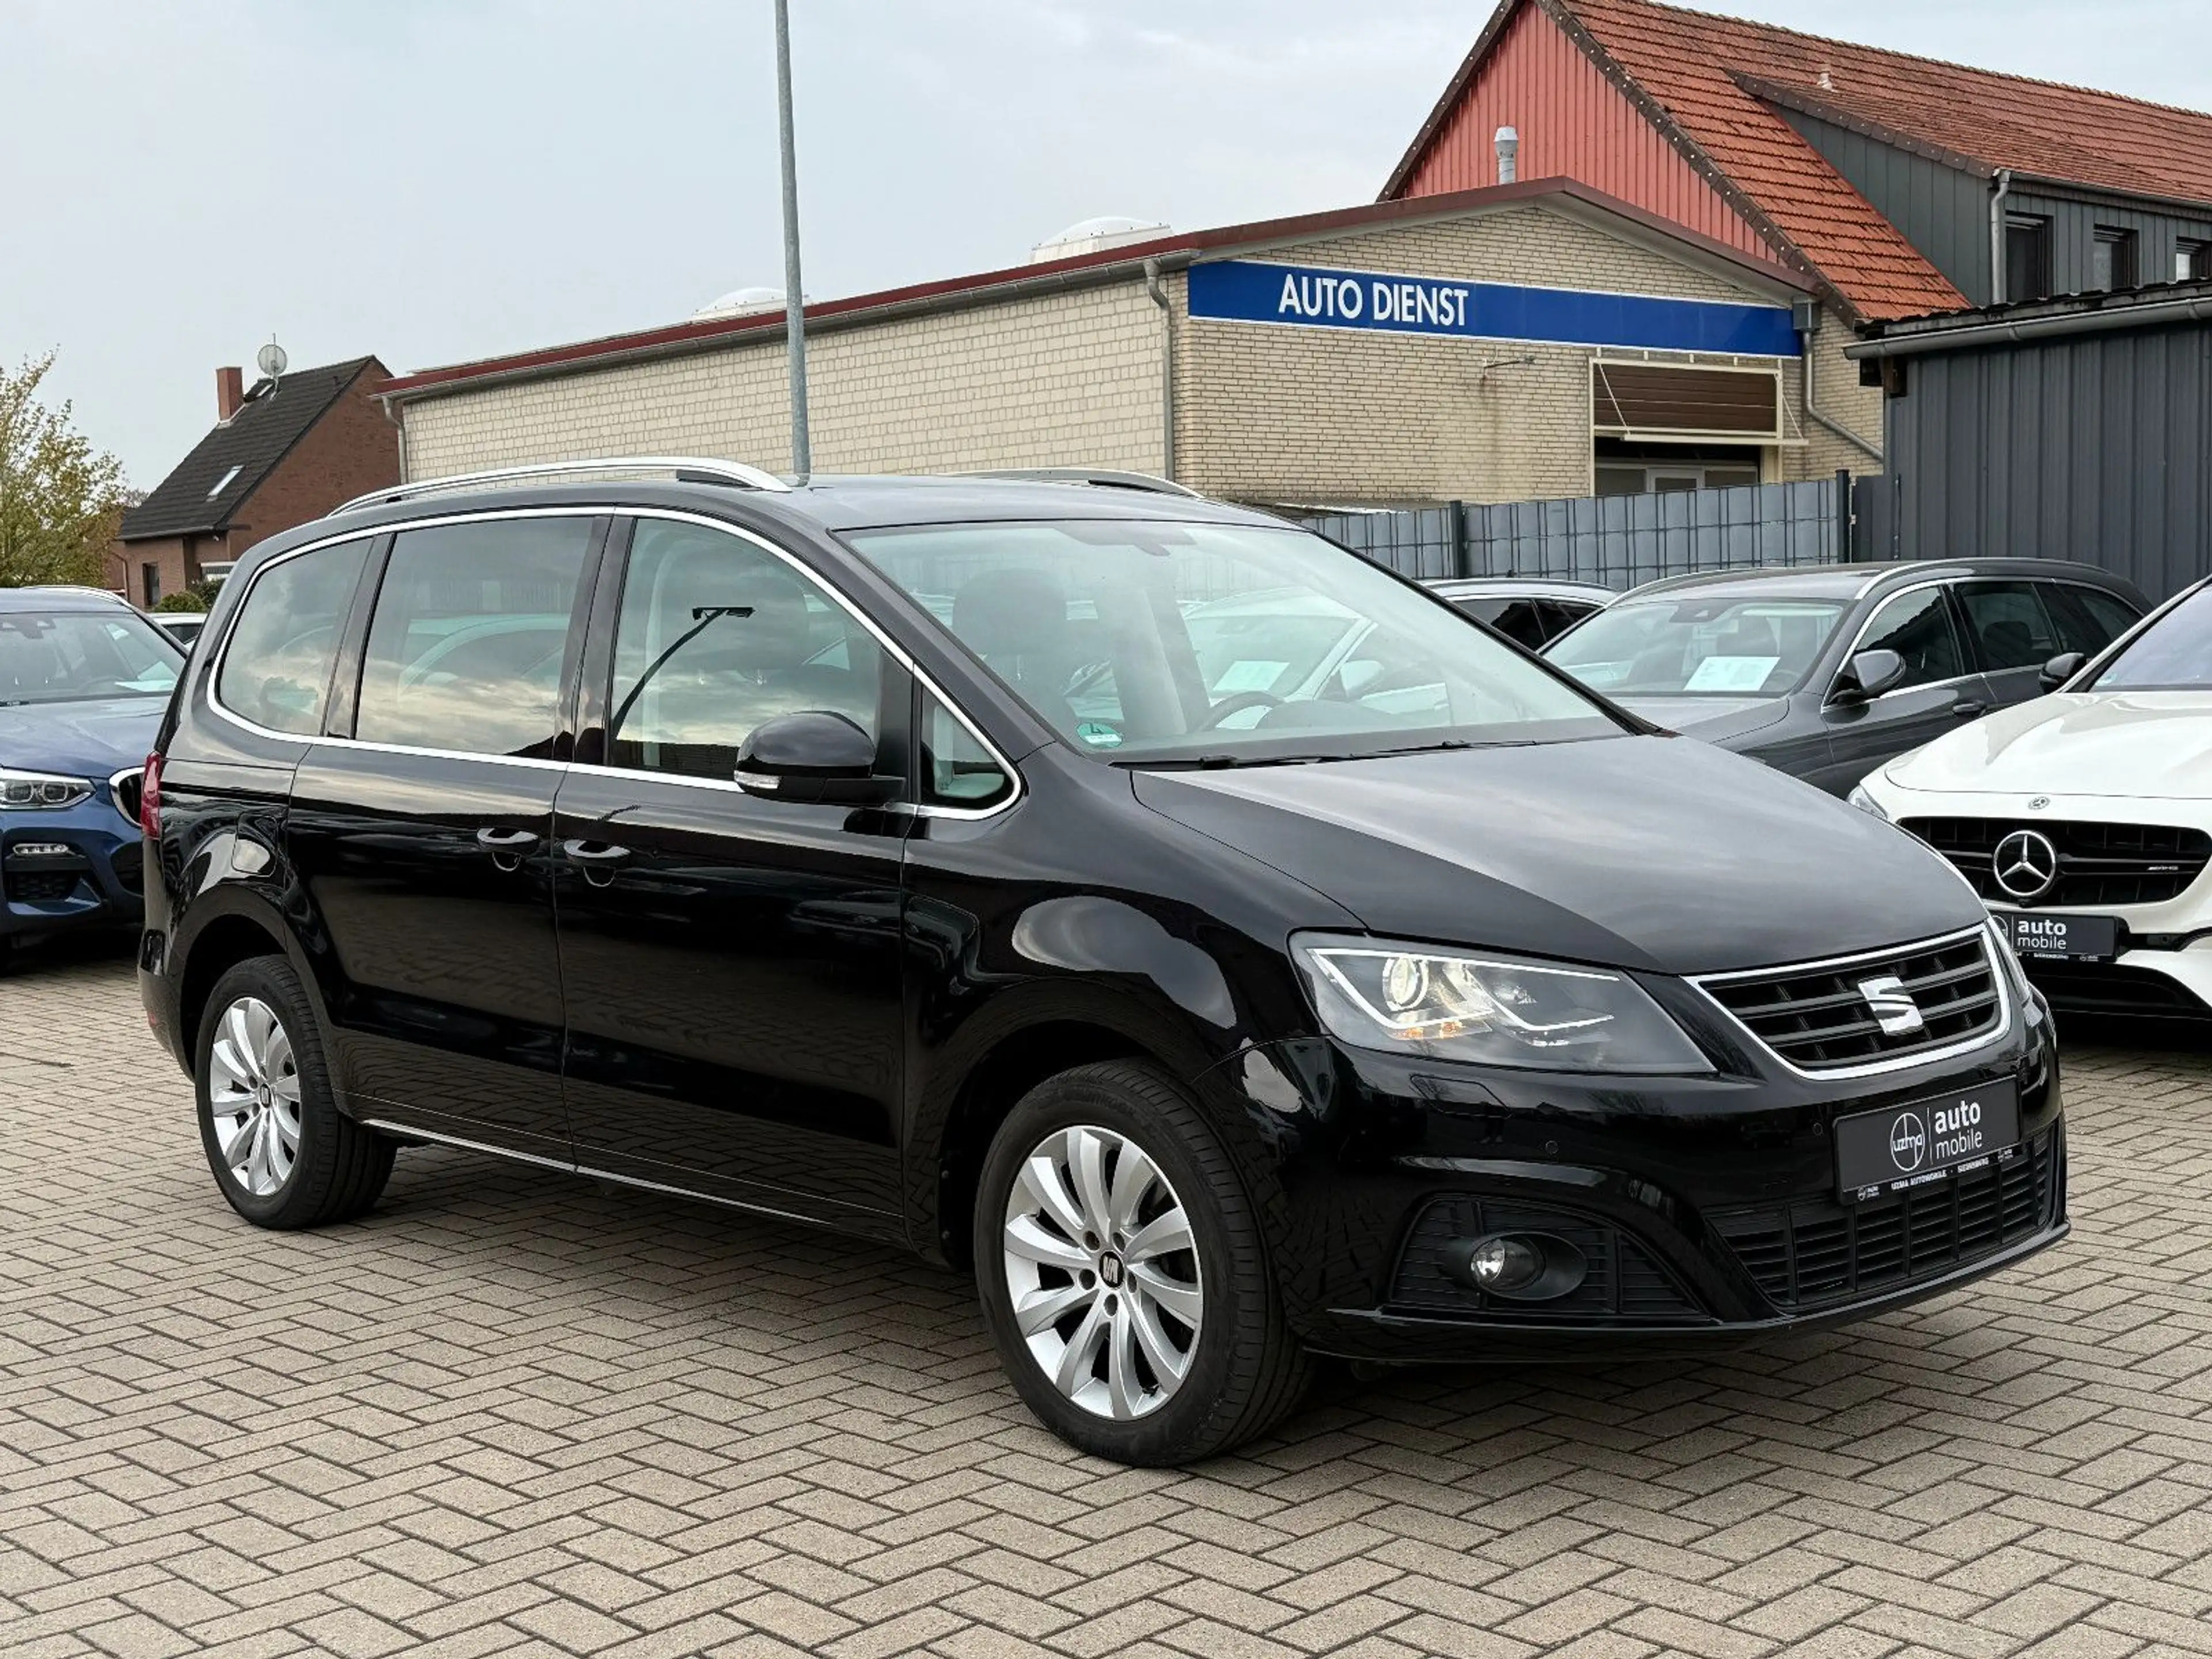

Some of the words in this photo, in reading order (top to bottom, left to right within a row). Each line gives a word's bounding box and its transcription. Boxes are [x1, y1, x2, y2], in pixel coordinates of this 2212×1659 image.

[1278, 274, 1363, 319] AUTO
[1373, 282, 1468, 327] DIENST
[2017, 935, 2067, 949] mobile
[2018, 919, 2067, 935] auto
[1935, 1100, 1981, 1134] auto
[1936, 1128, 1983, 1159] mobile
